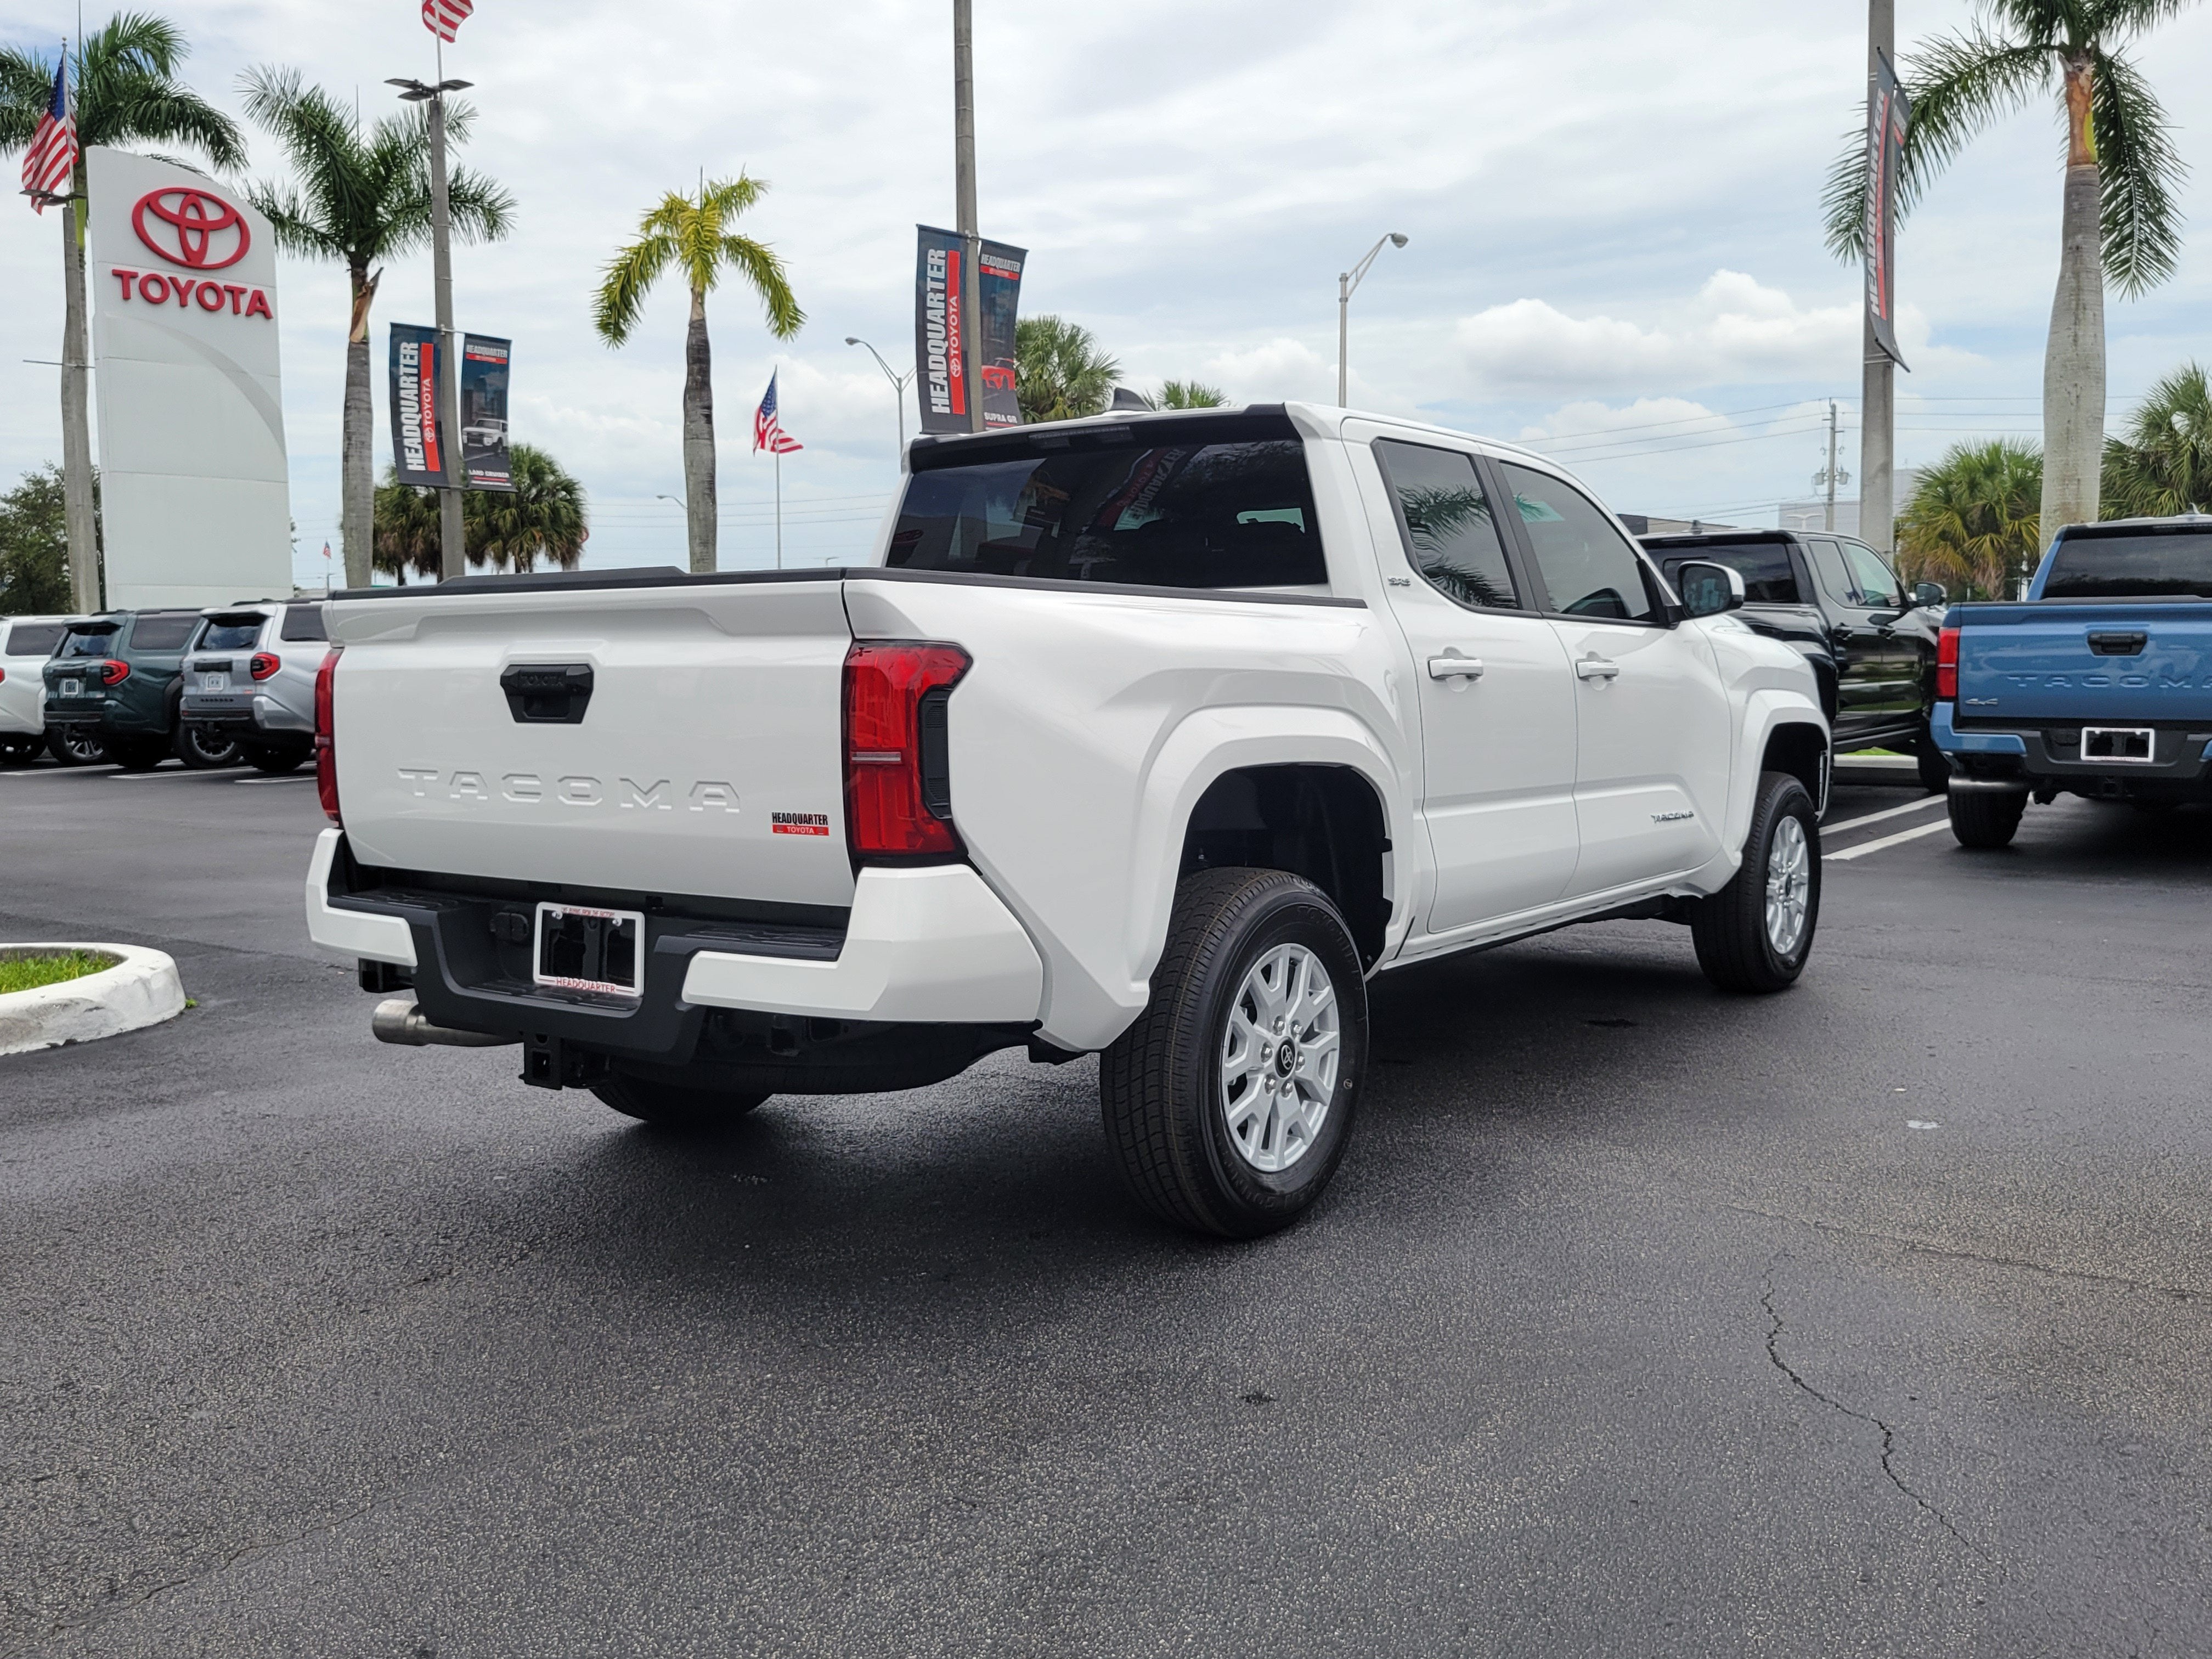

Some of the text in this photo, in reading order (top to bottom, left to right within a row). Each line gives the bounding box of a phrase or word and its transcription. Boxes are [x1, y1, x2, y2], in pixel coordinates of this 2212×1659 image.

[1866, 87, 1884, 317] HEADQUARTER
[112, 269, 273, 319] TOYOTA
[927, 249, 950, 414] HEADQUARTER
[949, 296, 958, 356] TOYOTA
[399, 342, 426, 471] HEADQUARTER
[423, 378, 433, 426] TOYOTA
[984, 412, 1007, 422] SUPRA
[398, 769, 741, 813] TACOMA
[772, 812, 828, 825] HEADQUARTER
[556, 977, 616, 994] HEADQUARTER
